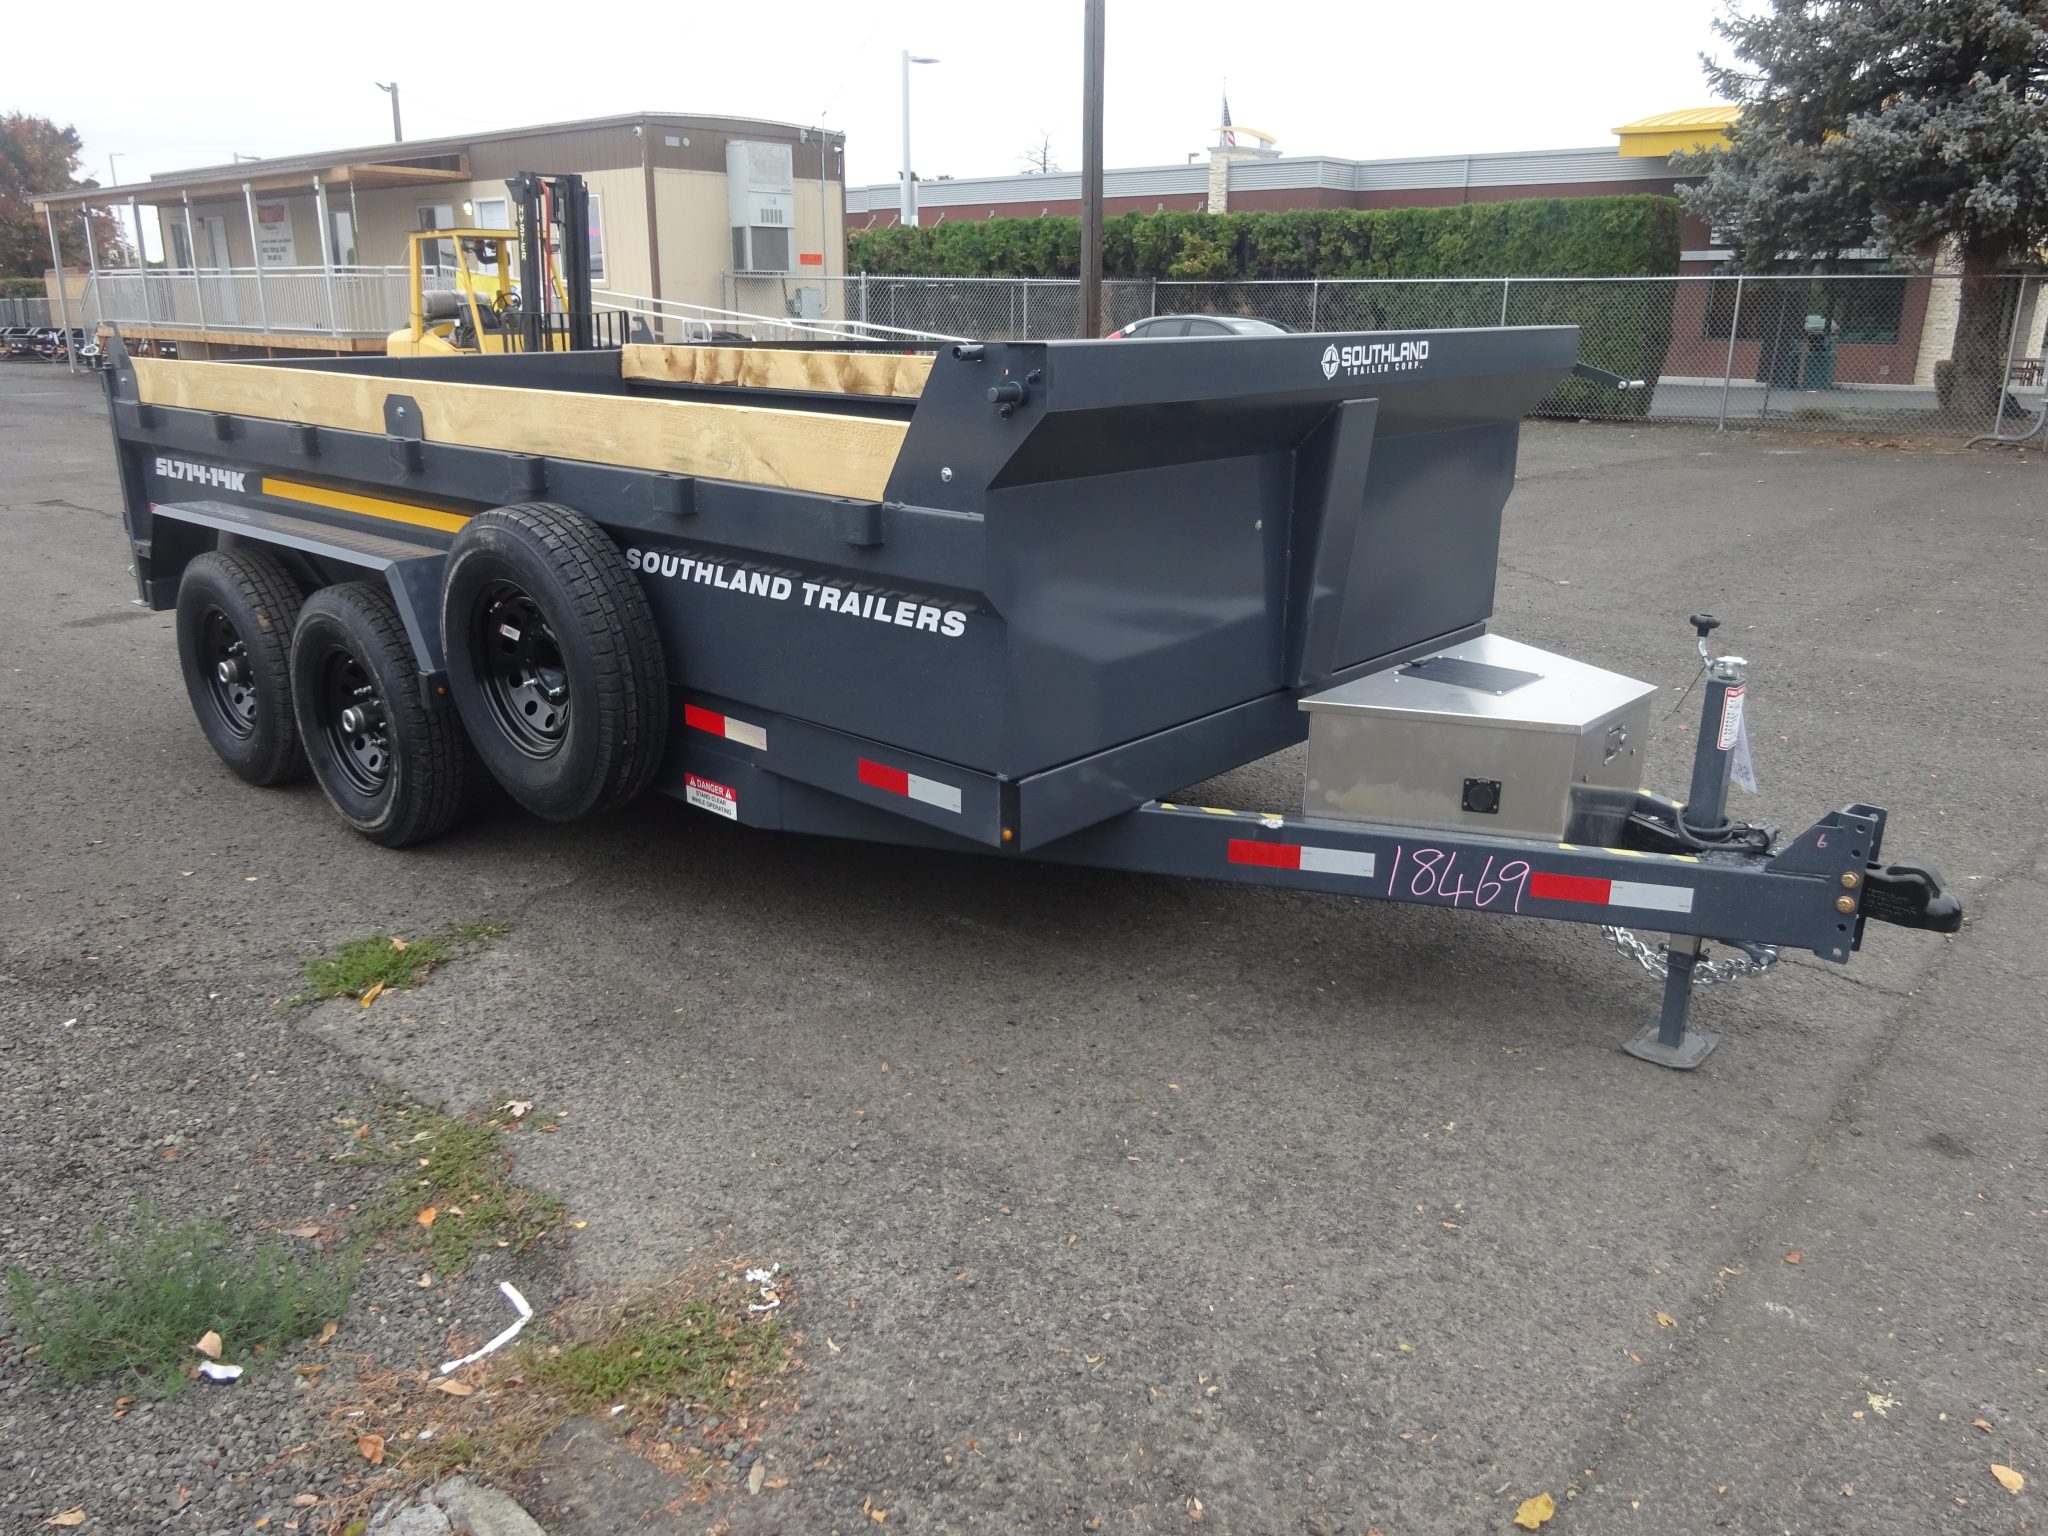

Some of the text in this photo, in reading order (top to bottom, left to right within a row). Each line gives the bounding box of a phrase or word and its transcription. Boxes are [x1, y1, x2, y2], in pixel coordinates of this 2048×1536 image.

[519, 204, 527, 262] HYSTER
[1341, 341, 1429, 367] SOUTHLAND
[1347, 361, 1423, 376] TRAILER CORP.
[156, 457, 246, 493] SL714-14K
[626, 547, 968, 637] SOUTHLAND TRAILERS
[696, 779, 724, 797] DANGER
[706, 801, 732, 816] OPERATING
[711, 796, 727, 807] CLEAR
[1816, 833, 1828, 848] 6
[1388, 845, 1530, 913] 18469
